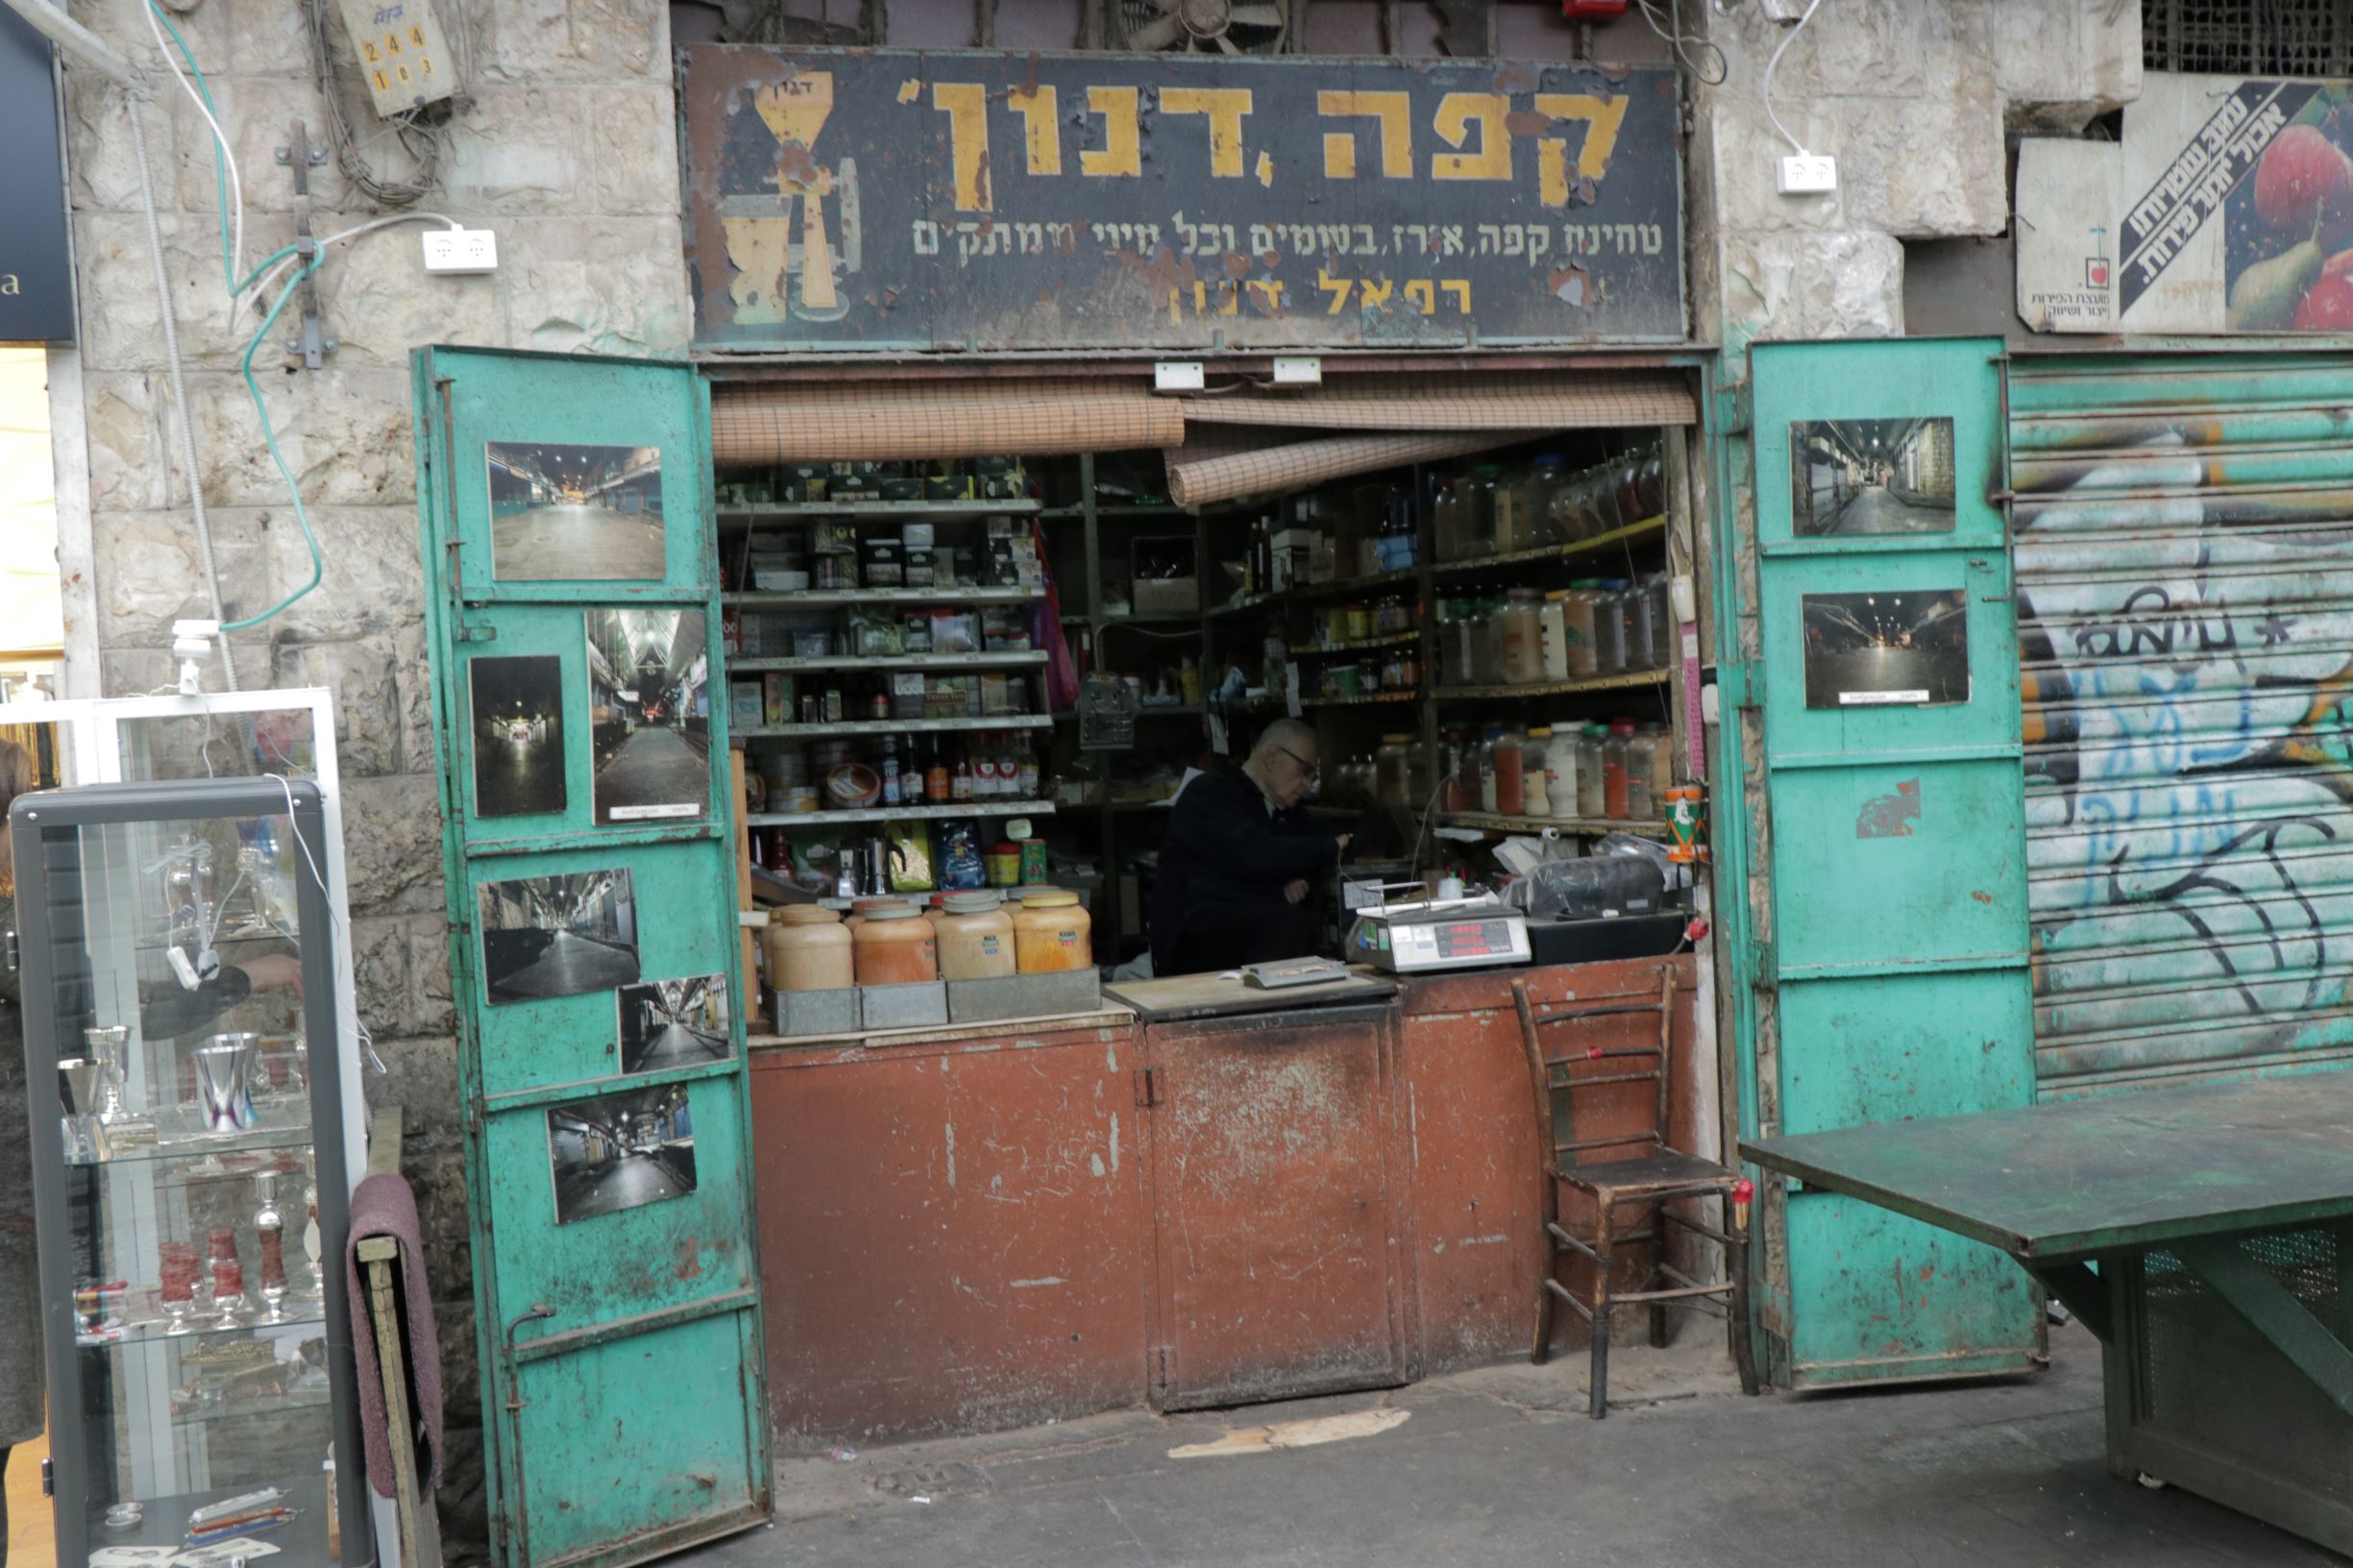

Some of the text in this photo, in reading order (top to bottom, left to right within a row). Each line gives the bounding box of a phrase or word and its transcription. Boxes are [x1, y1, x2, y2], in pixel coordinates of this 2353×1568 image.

[1317, 90, 1630, 207] קפה
[2230, 102, 2287, 163] אכול
[1172, 209, 1236, 257] וכל
[1563, 223, 1662, 256] טחינת
[1318, 269, 1472, 315] רפאל
